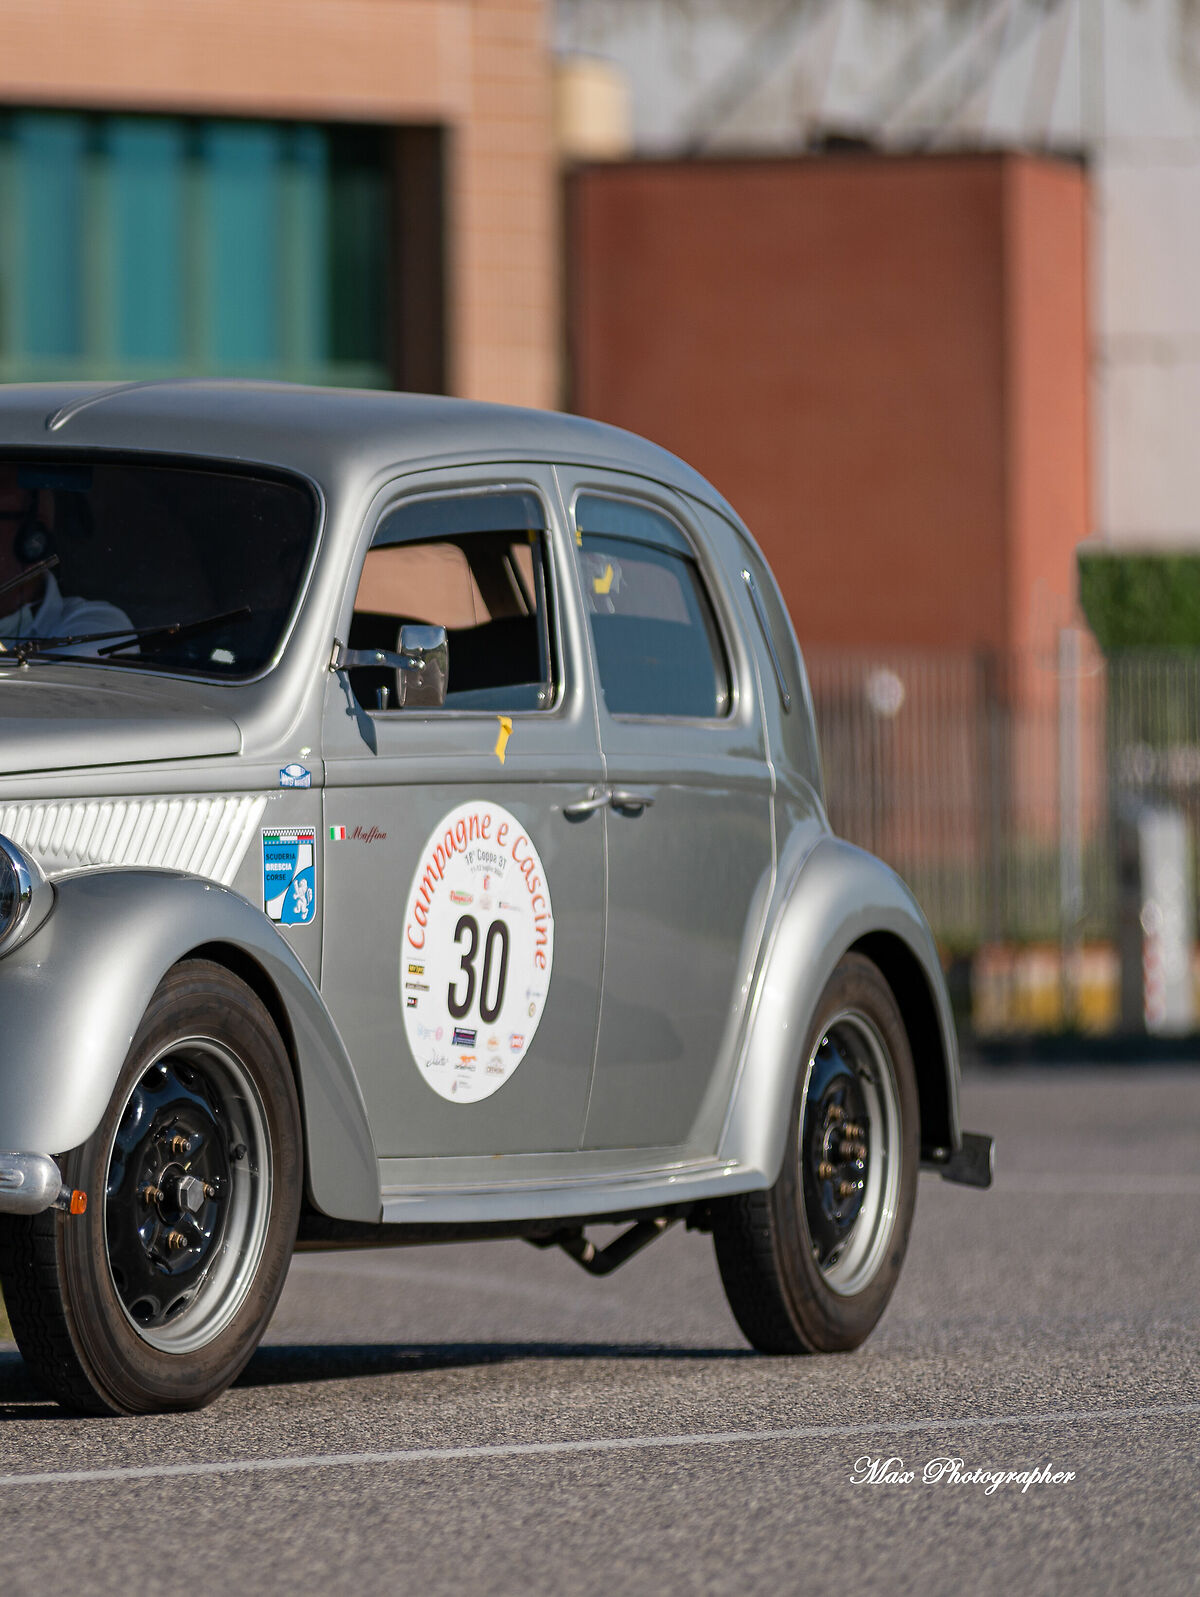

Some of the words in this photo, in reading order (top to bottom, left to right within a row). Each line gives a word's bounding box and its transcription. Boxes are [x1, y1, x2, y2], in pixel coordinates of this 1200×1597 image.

[265, 853, 296, 861] SCUDERIA
[477, 848, 497, 863] Coppa
[265, 863, 292, 871] BRESCIA
[407, 814, 491, 949] Campagne
[497, 822, 508, 846] e
[512, 836, 550, 970] Cascine
[448, 914, 510, 1024] 30
